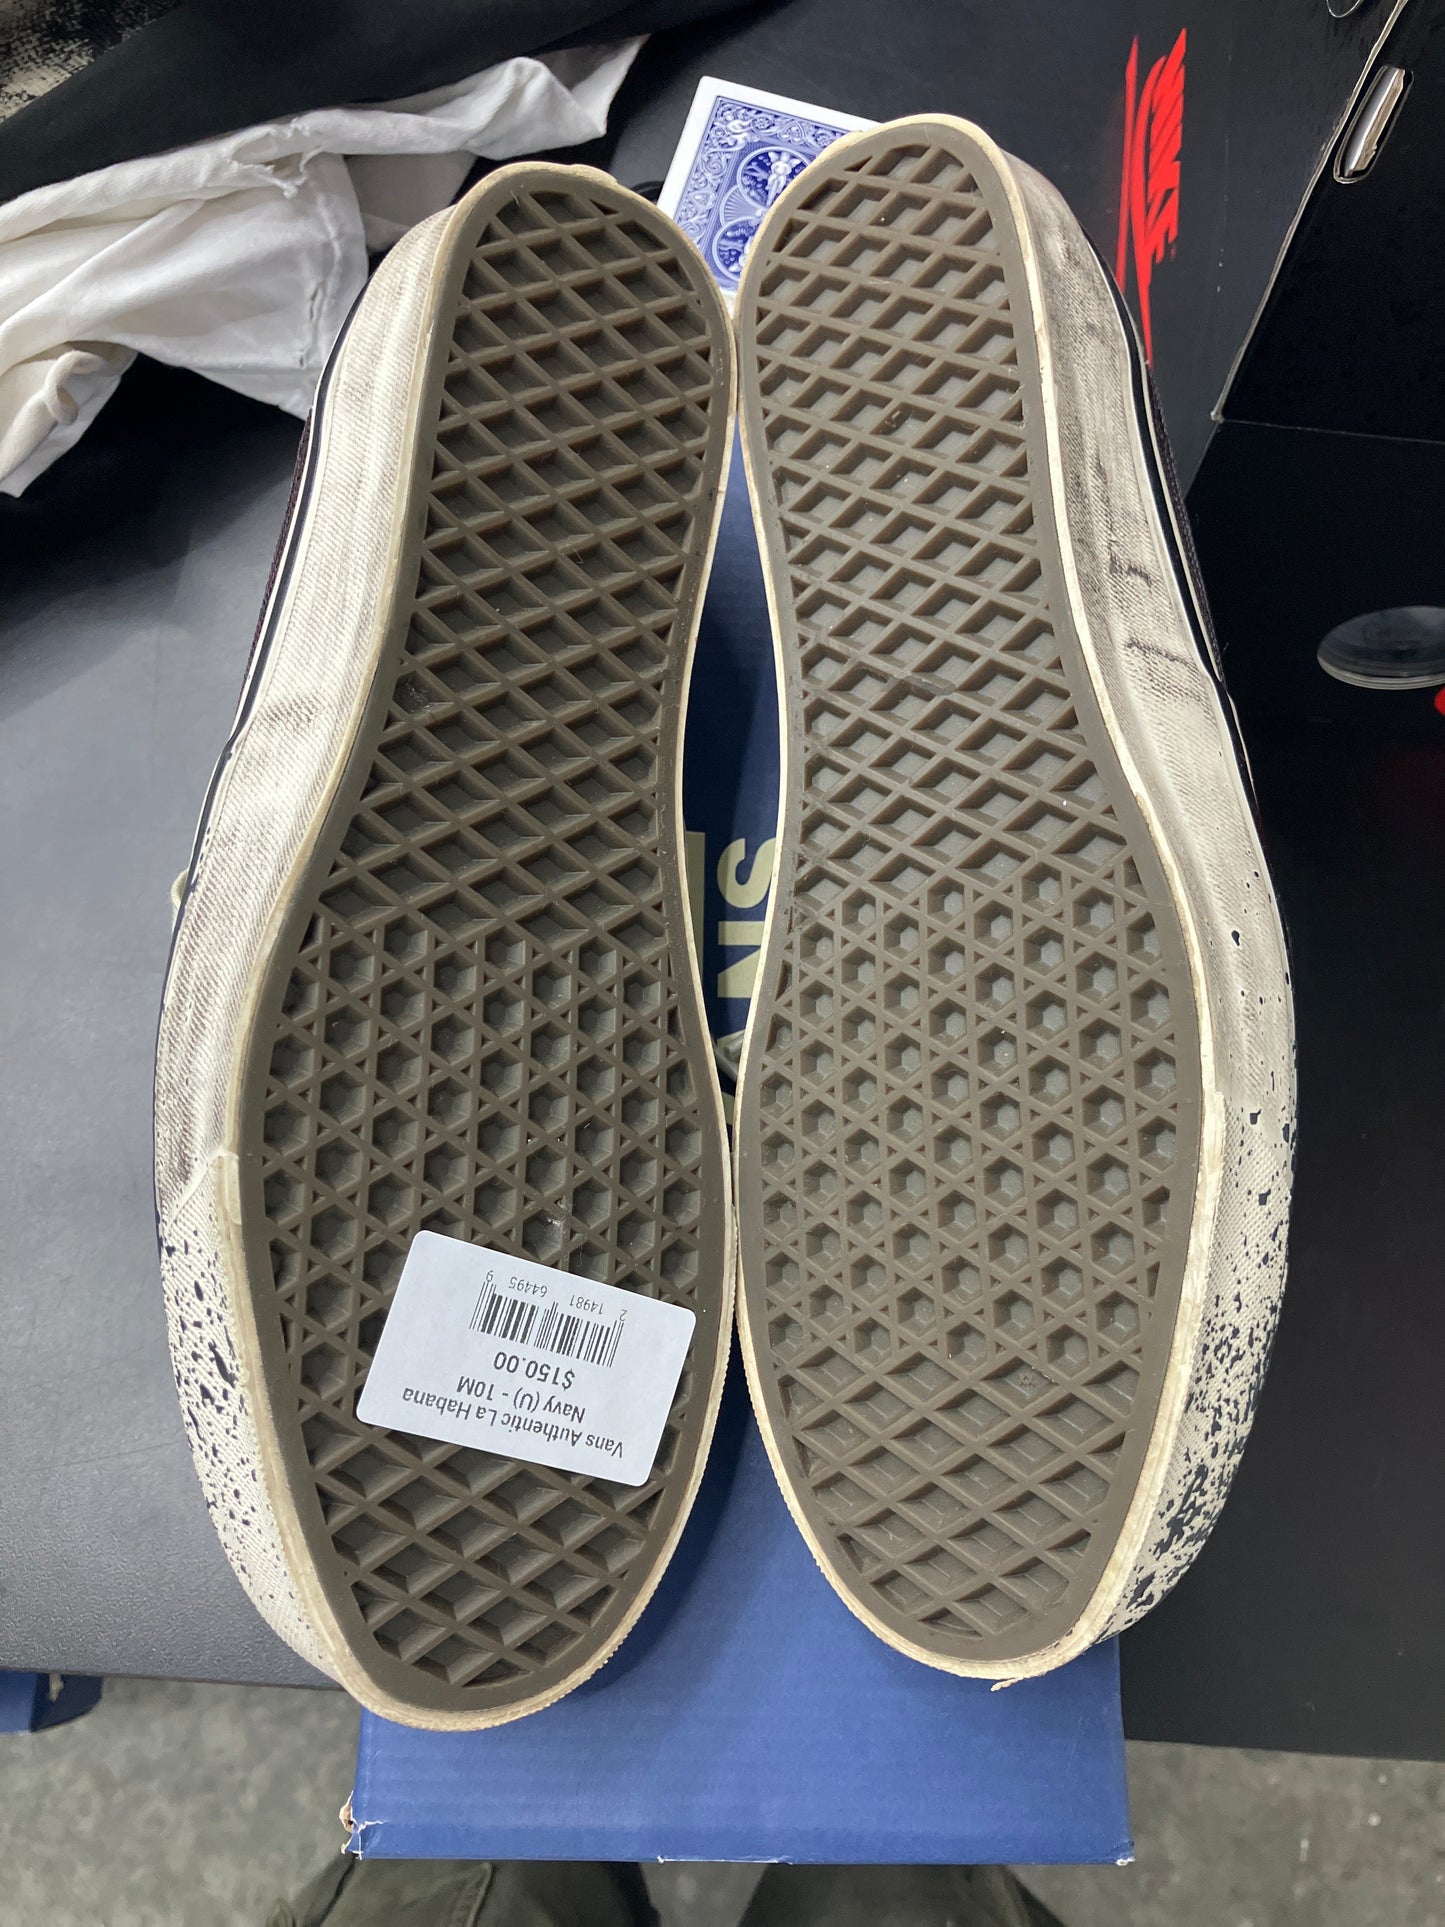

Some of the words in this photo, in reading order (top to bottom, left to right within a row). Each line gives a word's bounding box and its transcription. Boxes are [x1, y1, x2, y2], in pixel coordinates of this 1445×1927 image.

[485, 1270, 494, 1283] 9
[508, 1276, 548, 1298] 64495
[569, 1294, 605, 1315] 14981
[618, 1309, 628, 1322] 2
[493, 1351, 576, 1391] $150.00
[456, 1376, 495, 1401] 10M
[513, 1387, 541, 1413] (U)
[402, 1387, 472, 1421] Habana
[476, 1405, 498, 1427] La
[543, 1395, 586, 1424] Navy
[501, 1412, 583, 1447] Authentic
[586, 1434, 624, 1459] Vans
